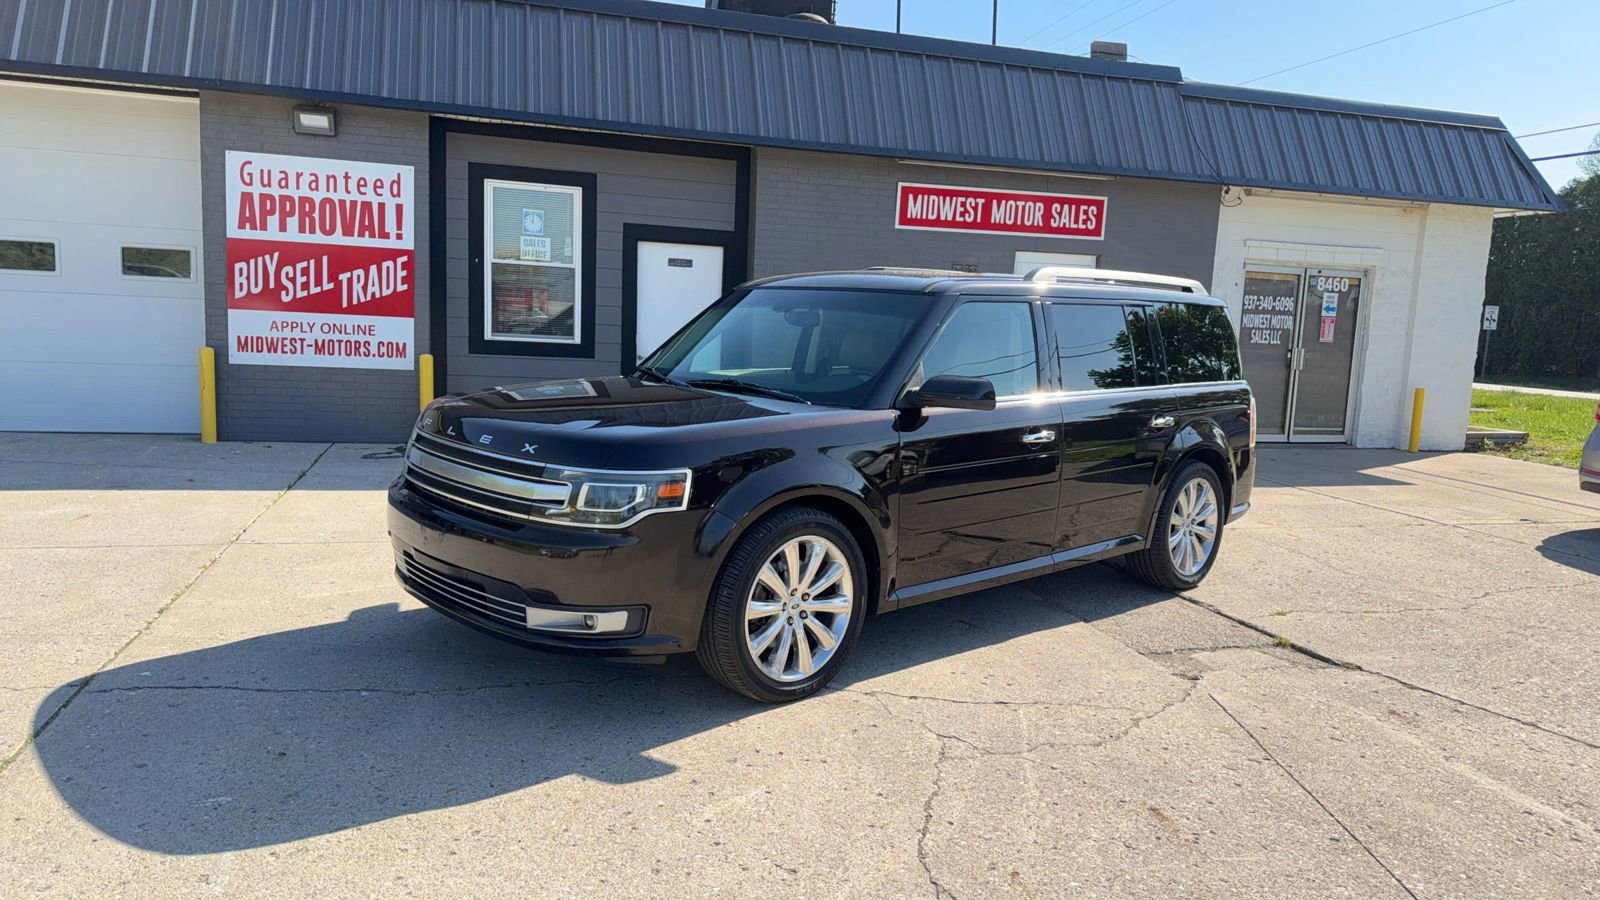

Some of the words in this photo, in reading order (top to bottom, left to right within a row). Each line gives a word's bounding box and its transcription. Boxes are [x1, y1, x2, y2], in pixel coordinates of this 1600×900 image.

[239, 160, 401, 198] Guaranteed
[237, 191, 404, 241] APPROVAL!
[906, 193, 985, 223] MIDWEST
[990, 199, 1044, 227] MOTOR
[1050, 203, 1098, 230] SALES
[522, 238, 546, 248] SALES
[234, 251, 280, 299] BUY
[280, 255, 334, 303] SELL
[338, 255, 408, 309] TRADE
[1317, 276, 1349, 292] 8460
[269, 320, 316, 335] APPLY
[320, 322, 376, 336] ONLINE
[1242, 313, 1271, 329] MIDWEST
[1271, 314, 1293, 330] MOTOR
[236, 335, 407, 359] MIDWEST-MOTORS.COM
[1250, 329, 1270, 344] SALES
[1270, 330, 1282, 344] LLC
[423, 418, 539, 454] FLEX
